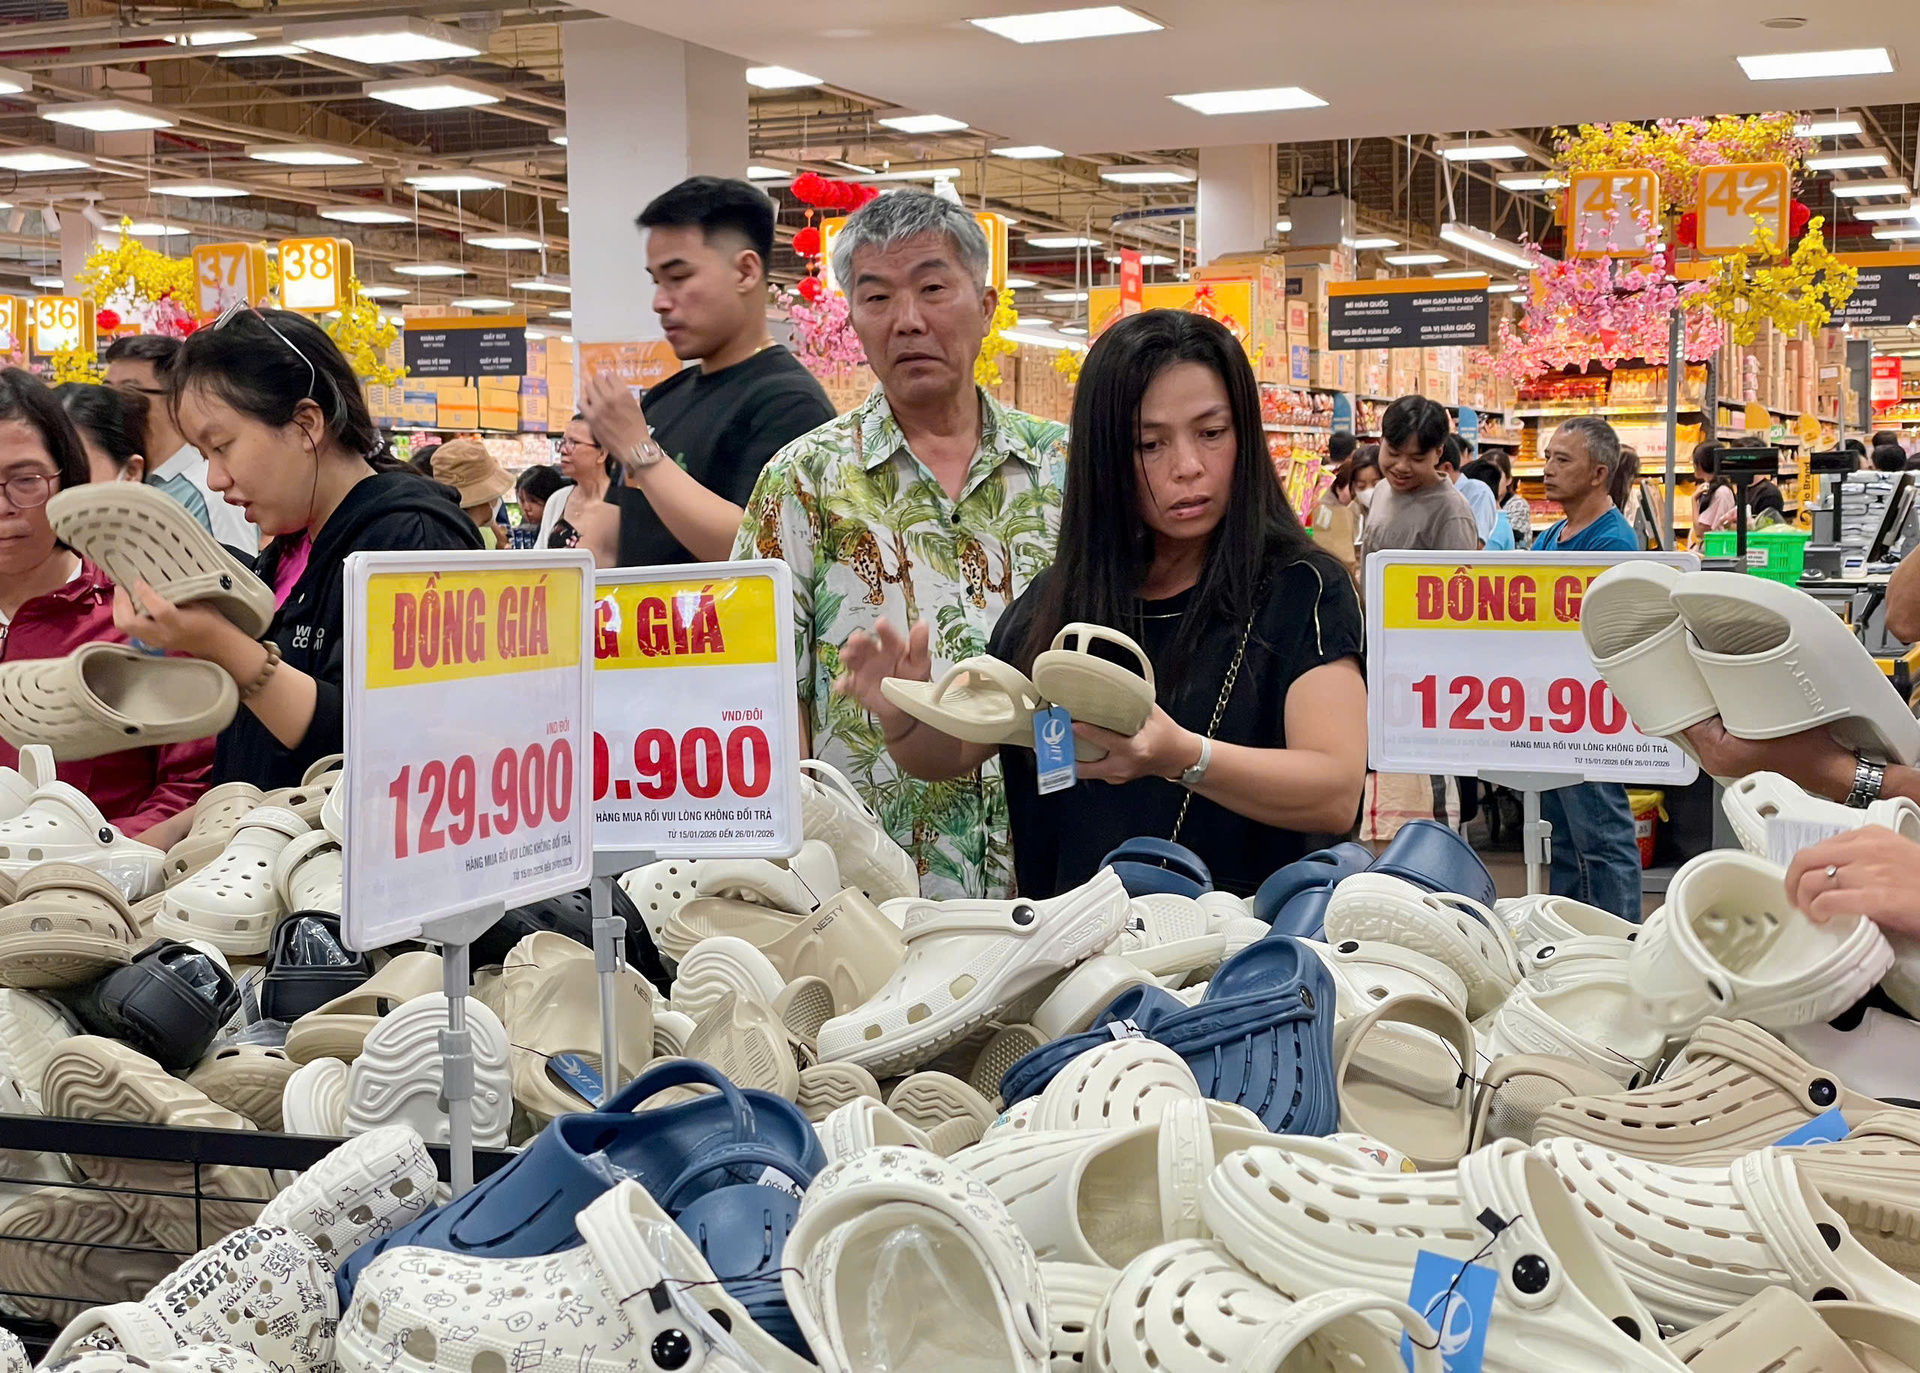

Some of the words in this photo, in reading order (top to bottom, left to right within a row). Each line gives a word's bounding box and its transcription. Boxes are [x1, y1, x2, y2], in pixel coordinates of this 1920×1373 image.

[1584, 174, 1642, 221] 41
[1707, 171, 1778, 217] 42
[200, 252, 245, 286] 37
[284, 242, 333, 280] 38
[40, 301, 77, 330] 36
[1415, 563, 1536, 622] ĐỒNG
[392, 571, 486, 670] ĐỒNG
[497, 574, 549, 660] GIÁ
[636, 584, 726, 658] GIÁ
[721, 707, 763, 722] VND/ĐÔI
[1411, 674, 1645, 735] 129.90
[1510, 739, 1531, 749] HÀNG
[1533, 741, 1550, 750] MUA
[1552, 740, 1566, 750] RỒI
[1568, 742, 1581, 750] VUI
[1583, 741, 1604, 751] LÒNG
[1605, 741, 1633, 752] KHÔNG
[1636, 741, 1650, 752] ĐỔI
[1652, 743, 1668, 753] TRẢ
[1585, 757, 1618, 766] 15/01/2026
[1619, 757, 1633, 766] ĐẾN
[1634, 759, 1670, 767] 26/01/2026
[388, 737, 574, 860] 129.900
[595, 811, 620, 822] HÀNG
[622, 812, 642, 821] MUA
[644, 808, 659, 821] RỒI
[661, 811, 675, 821] VUI
[678, 809, 701, 821] LÒNG
[704, 808, 734, 821] KHÔNG
[736, 806, 752, 820] ĐỔI
[754, 807, 772, 820] TRẢ
[465, 855, 483, 872] HÀNG
[484, 852, 497, 867] MUA
[561, 831, 571, 846] TRẢ
[667, 829, 677, 838] TỪ
[679, 830, 717, 839] 15/01/2026
[718, 828, 733, 838] ĐẾN
[735, 829, 775, 838] 26/01/2026
[811, 904, 844, 934] NESTY
[173, 1262, 233, 1318] TIMS
[242, 1275, 259, 1295] HOT
[220, 1292, 241, 1315] MOM
